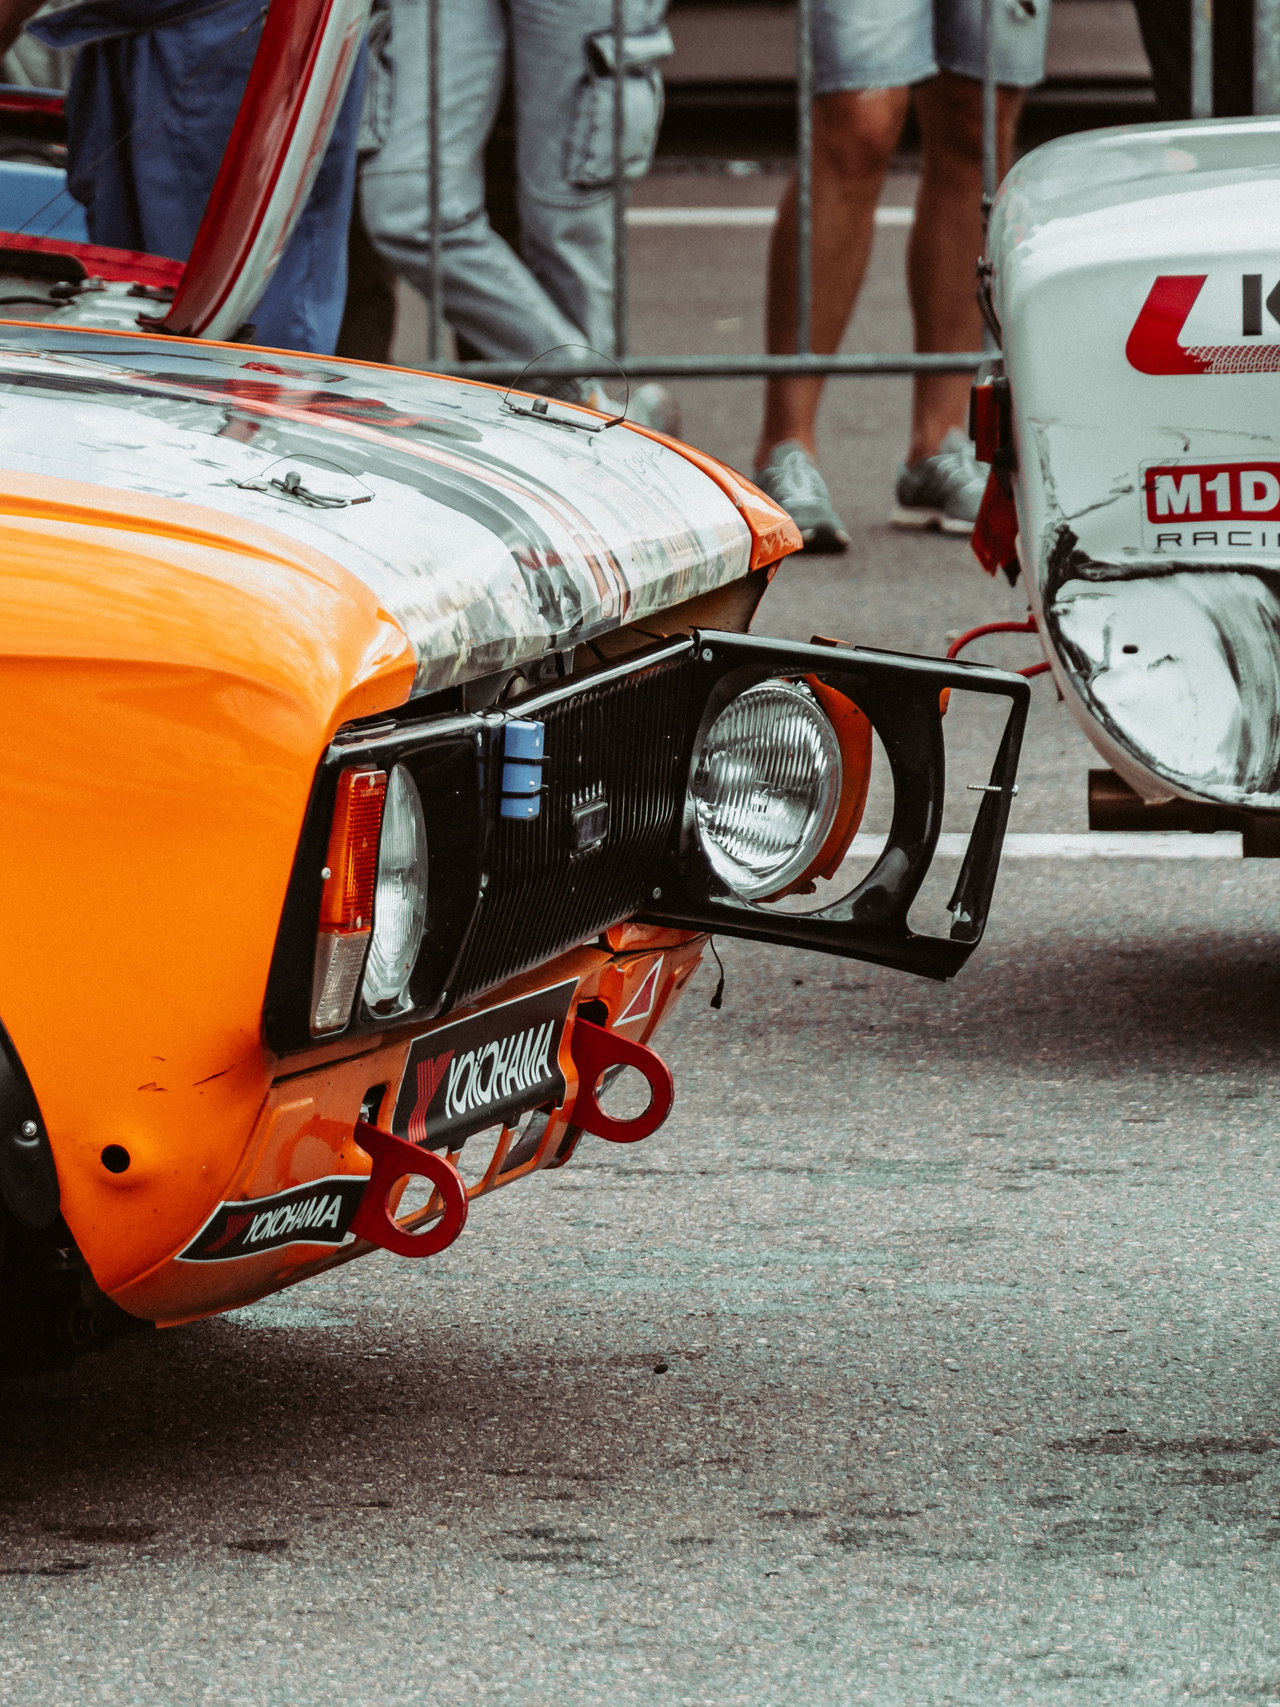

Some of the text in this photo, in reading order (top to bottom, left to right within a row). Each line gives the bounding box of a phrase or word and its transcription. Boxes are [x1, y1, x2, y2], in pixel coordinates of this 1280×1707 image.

[1154, 470, 1280, 515] M1D
[1157, 531, 1280, 548] RACI
[445, 1019, 555, 1119] YOKOHAMA
[242, 1194, 342, 1245] YOKOHAMA
